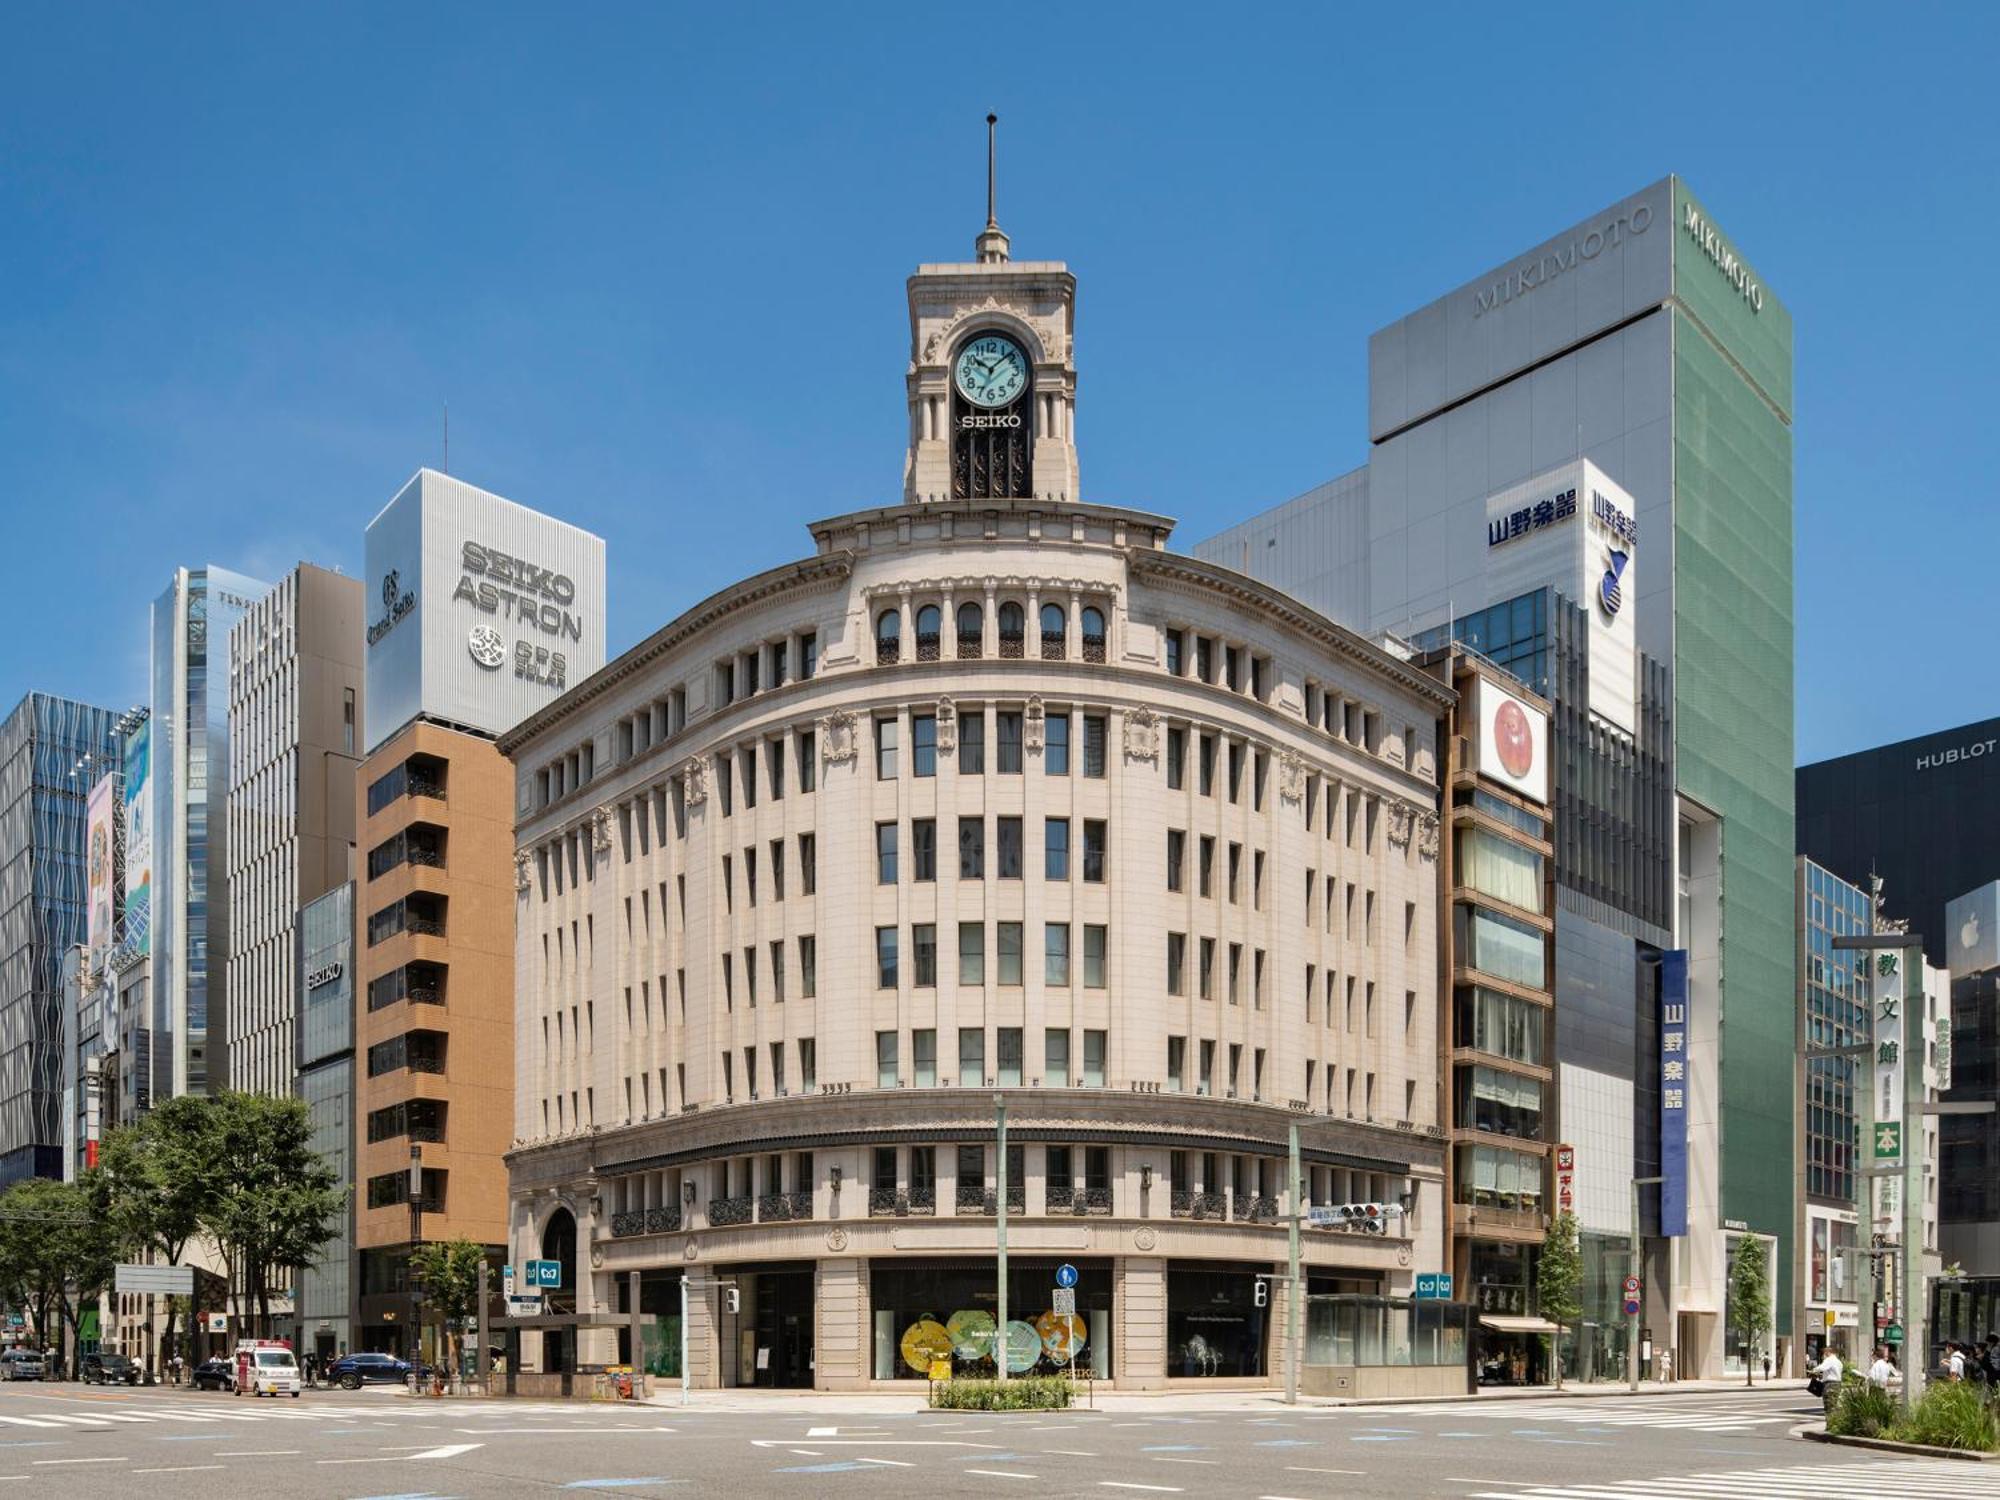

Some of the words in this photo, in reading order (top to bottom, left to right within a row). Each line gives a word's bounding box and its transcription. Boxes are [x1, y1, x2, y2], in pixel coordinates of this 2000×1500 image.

[1474, 205, 1654, 318] MIKIMOTO
[1684, 202, 1763, 313] MIKIMOTO
[986, 342, 997, 353] 12
[963, 366, 971, 377] 9
[967, 377, 975, 388] 8
[1007, 377, 1015, 388] 4
[1012, 366, 1020, 376] 3
[977, 386, 985, 397] 7
[987, 389, 995, 400] 6
[998, 386, 1006, 397] 5
[962, 415, 1021, 428] SEIKO
[1489, 488, 1577, 546] 山野楽器
[1594, 489, 1637, 546] 山野楽器
[462, 541, 576, 604] SEIKO
[453, 575, 582, 642] ASTRON
[515, 640, 566, 672] GPS
[1916, 739, 1997, 770] HUBLOT
[307, 961, 342, 990] SEIKO
[1878, 953, 1899, 1065] 教文館
[1664, 1004, 1684, 1109] 山野楽器
[1876, 1127, 1898, 1153] 本
